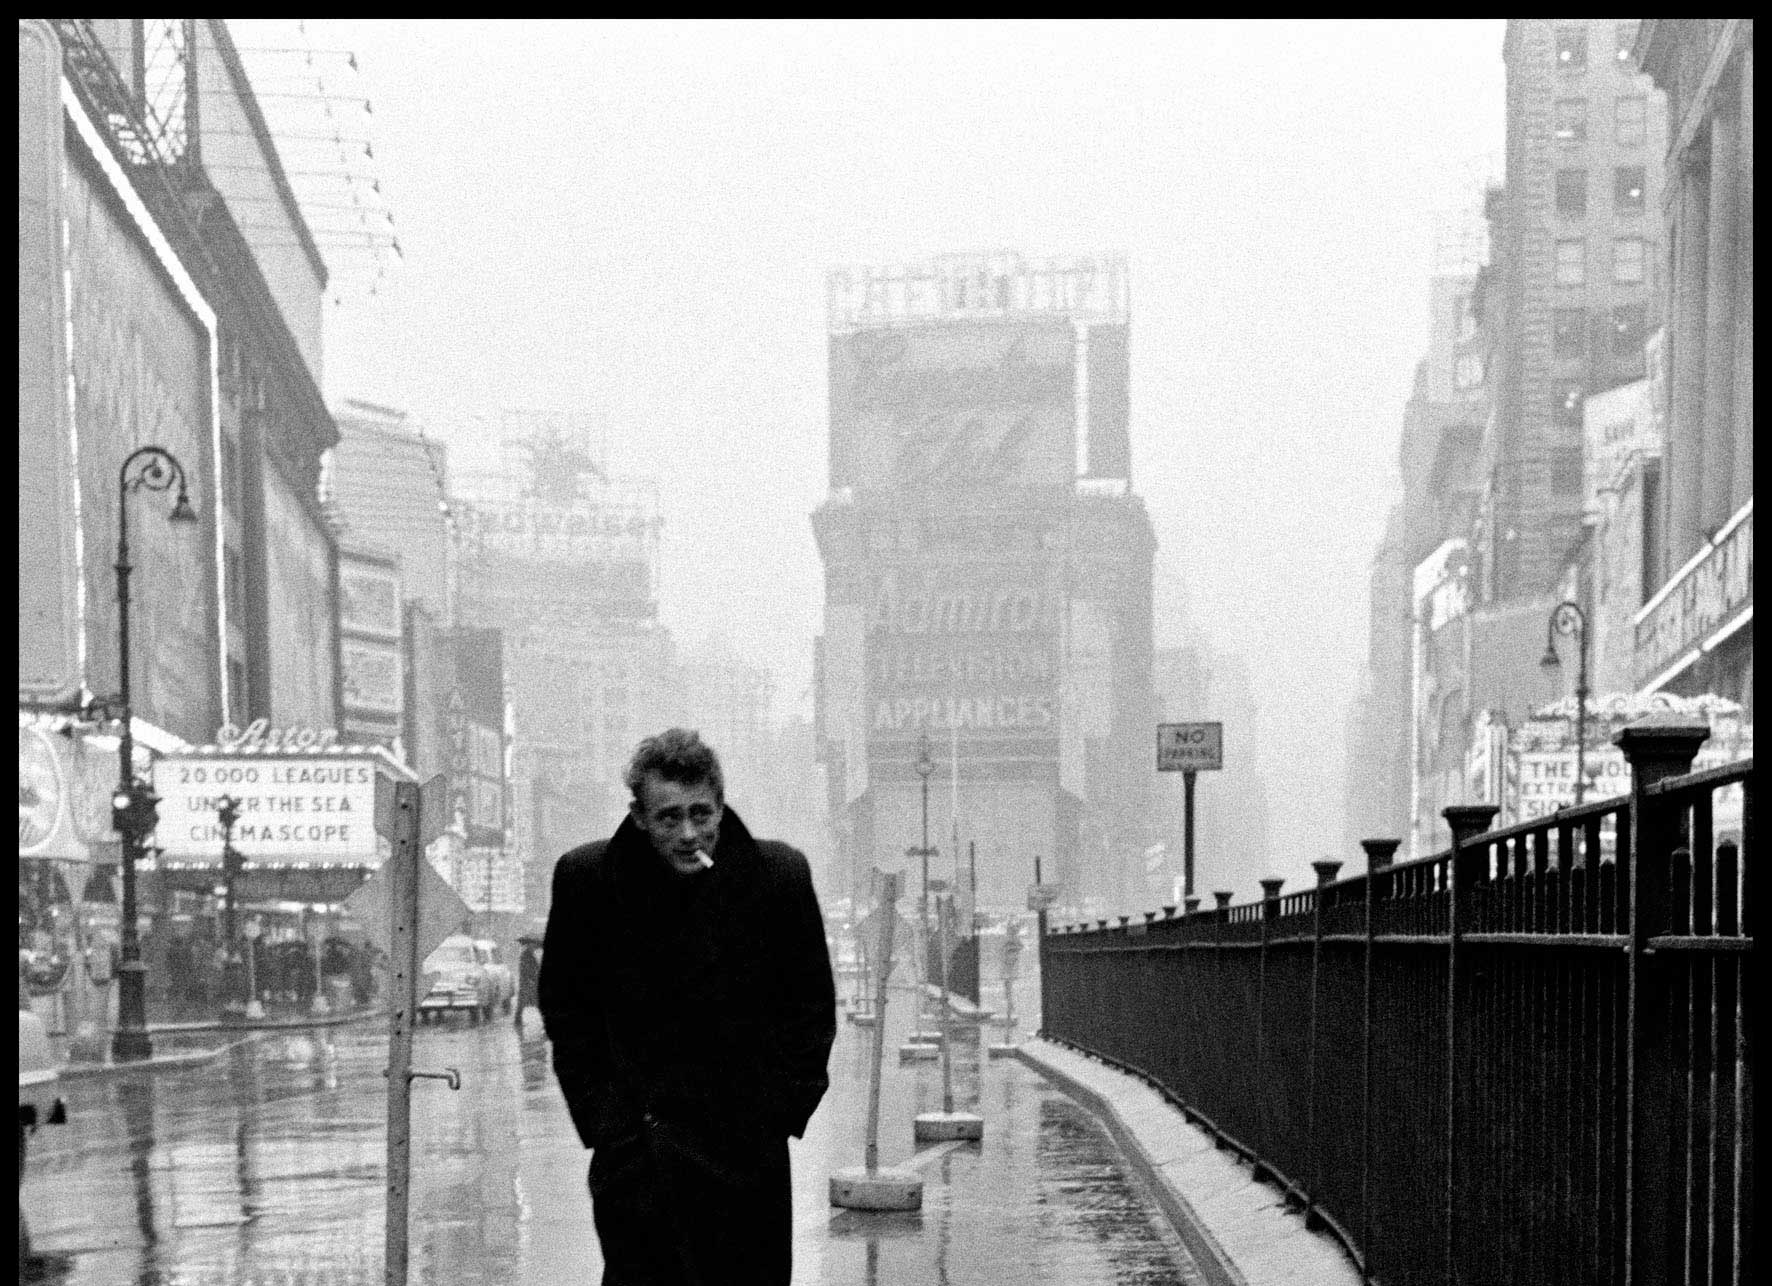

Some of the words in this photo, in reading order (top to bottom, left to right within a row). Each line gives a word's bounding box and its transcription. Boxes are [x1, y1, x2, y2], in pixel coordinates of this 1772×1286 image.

[874, 696, 1051, 728] APPLIANCES
[217, 718, 338, 746] Astor
[1175, 729, 1206, 744] NO
[180, 768, 207, 784] 20
[273, 768, 369, 784] LEAGUES
[1530, 761, 1572, 778] THE
[188, 796, 260, 812] UNR
[267, 797, 306, 812] THE
[311, 797, 352, 812] SEA
